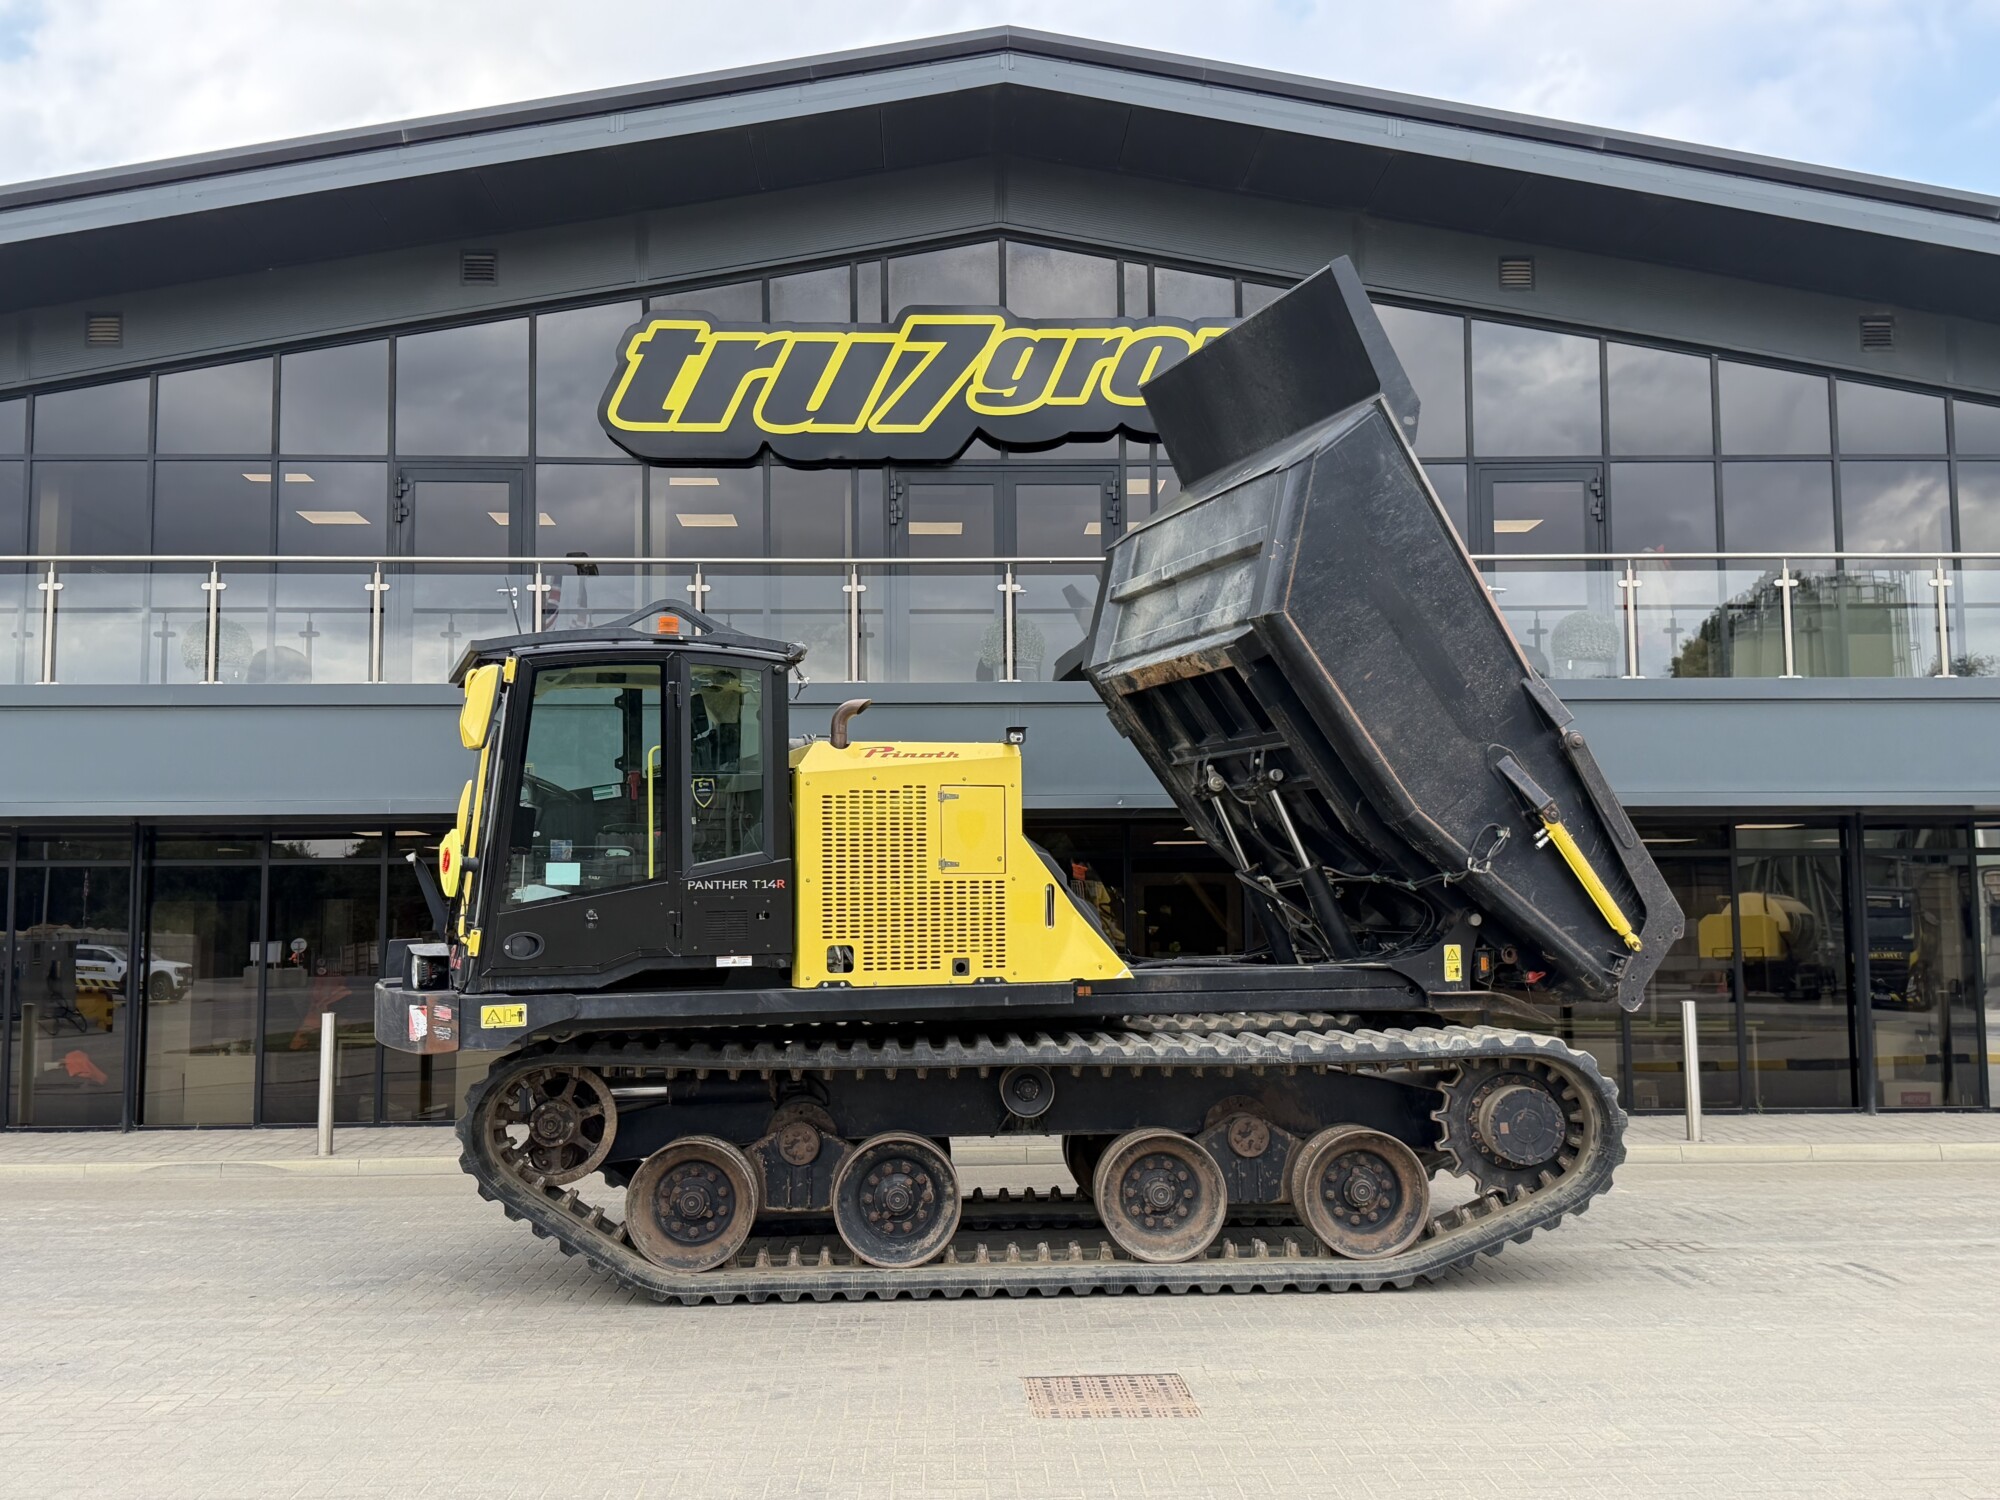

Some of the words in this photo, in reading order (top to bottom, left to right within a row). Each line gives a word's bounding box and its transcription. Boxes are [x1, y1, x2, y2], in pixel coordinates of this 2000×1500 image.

[607, 314, 1231, 433] tru7gro
[860, 746, 959, 758] Prinoth
[687, 880, 748, 890] PANTHER
[752, 879, 785, 889] T14R
